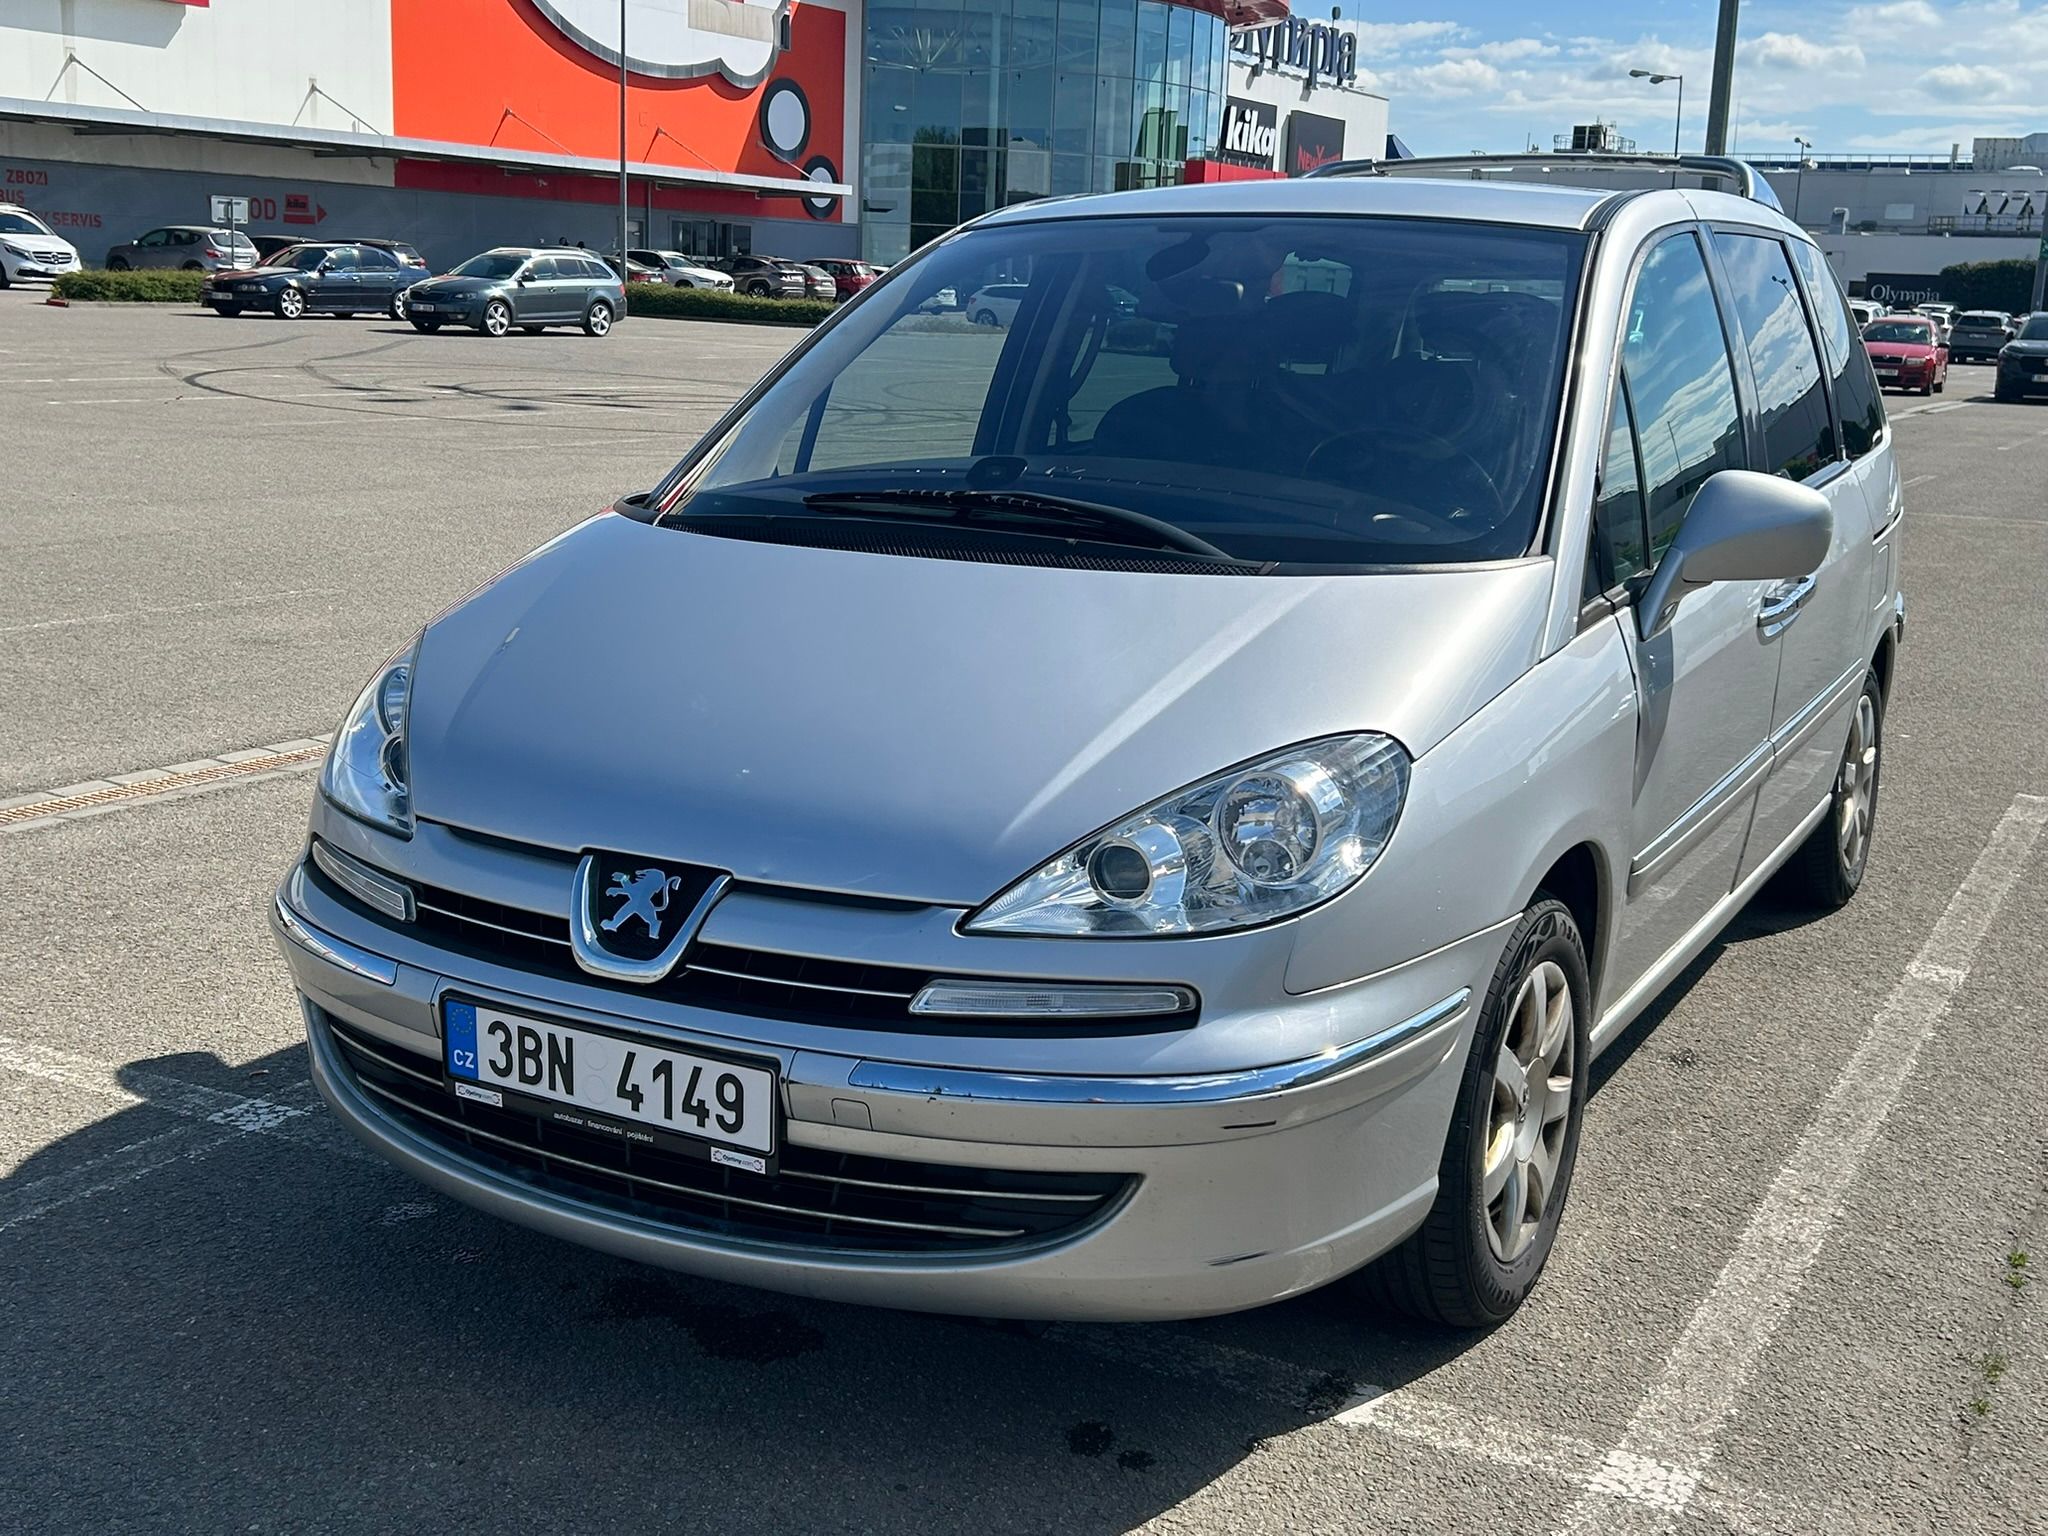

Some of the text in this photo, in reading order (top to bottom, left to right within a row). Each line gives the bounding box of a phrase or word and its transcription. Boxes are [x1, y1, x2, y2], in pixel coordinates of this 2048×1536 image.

[1225, 106, 1276, 156] kika
[52, 211, 103, 228] SERVIS
[1870, 284, 1940, 304] Olympia
[453, 1048, 475, 1069] CZ
[487, 1020, 744, 1134] 3BN 4149
